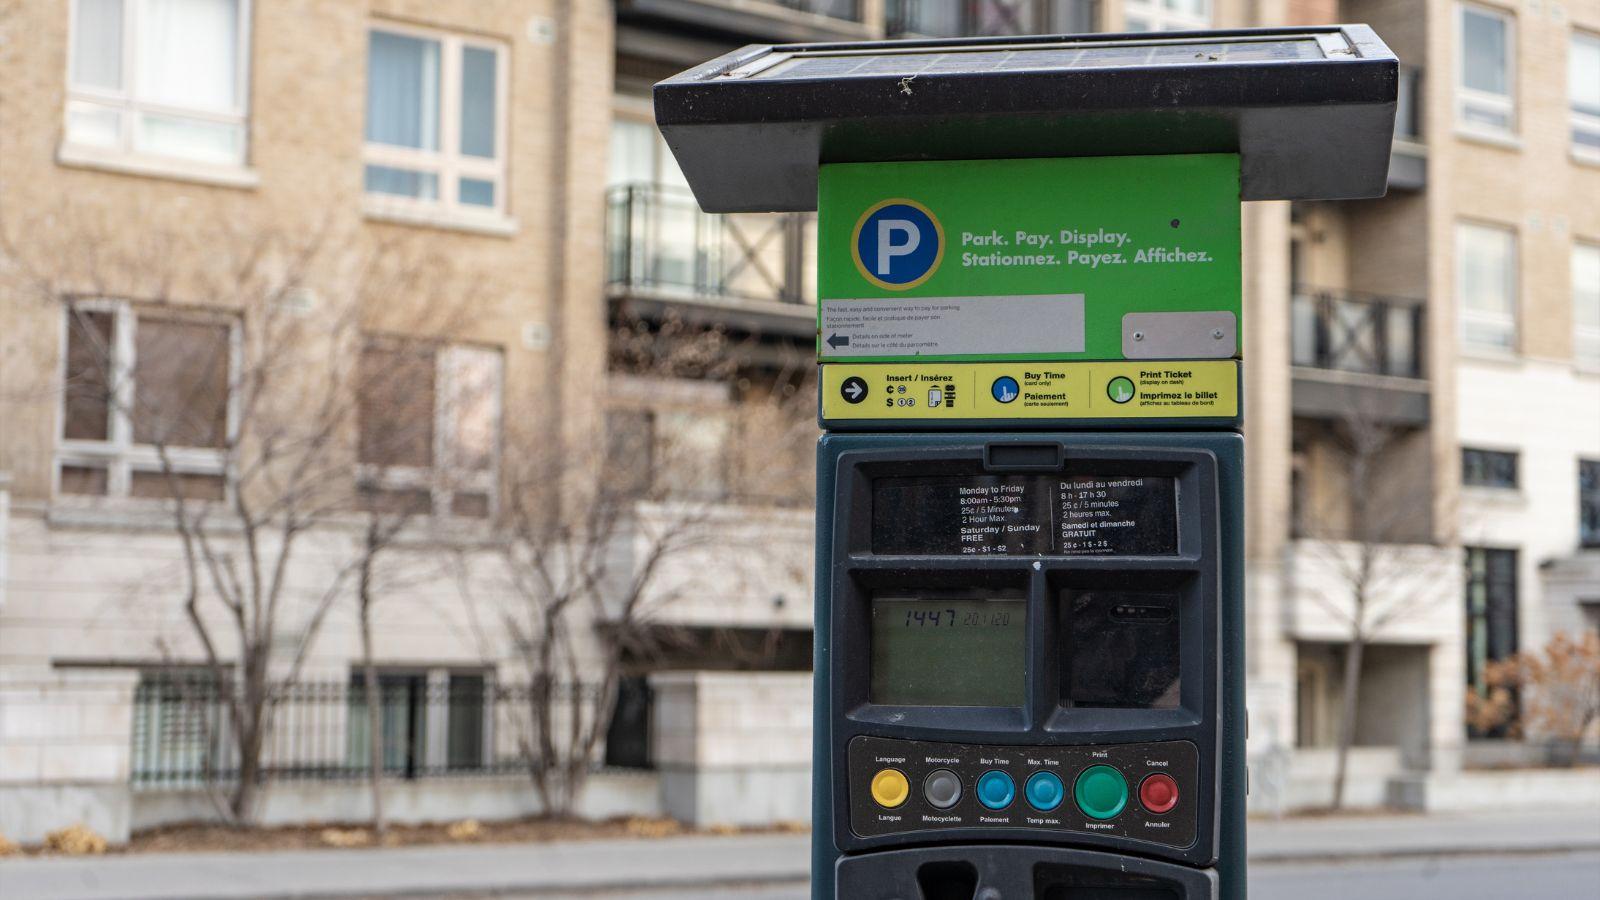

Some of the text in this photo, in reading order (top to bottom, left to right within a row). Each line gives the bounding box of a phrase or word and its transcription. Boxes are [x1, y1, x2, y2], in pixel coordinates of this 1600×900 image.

[962, 228, 1131, 249] Park. Pay. Display.
[878, 219, 920, 275] P
[962, 247, 1213, 268] Stationnez. Payez. Affichez.
[1024, 372, 1041, 380] Buy
[1140, 392, 1181, 400] Imprimez
[1107, 479, 1143, 488] vendredi
[1000, 485, 1024, 494] Friday
[960, 526, 1000, 534] Saturday
[906, 609, 955, 627] 1447
